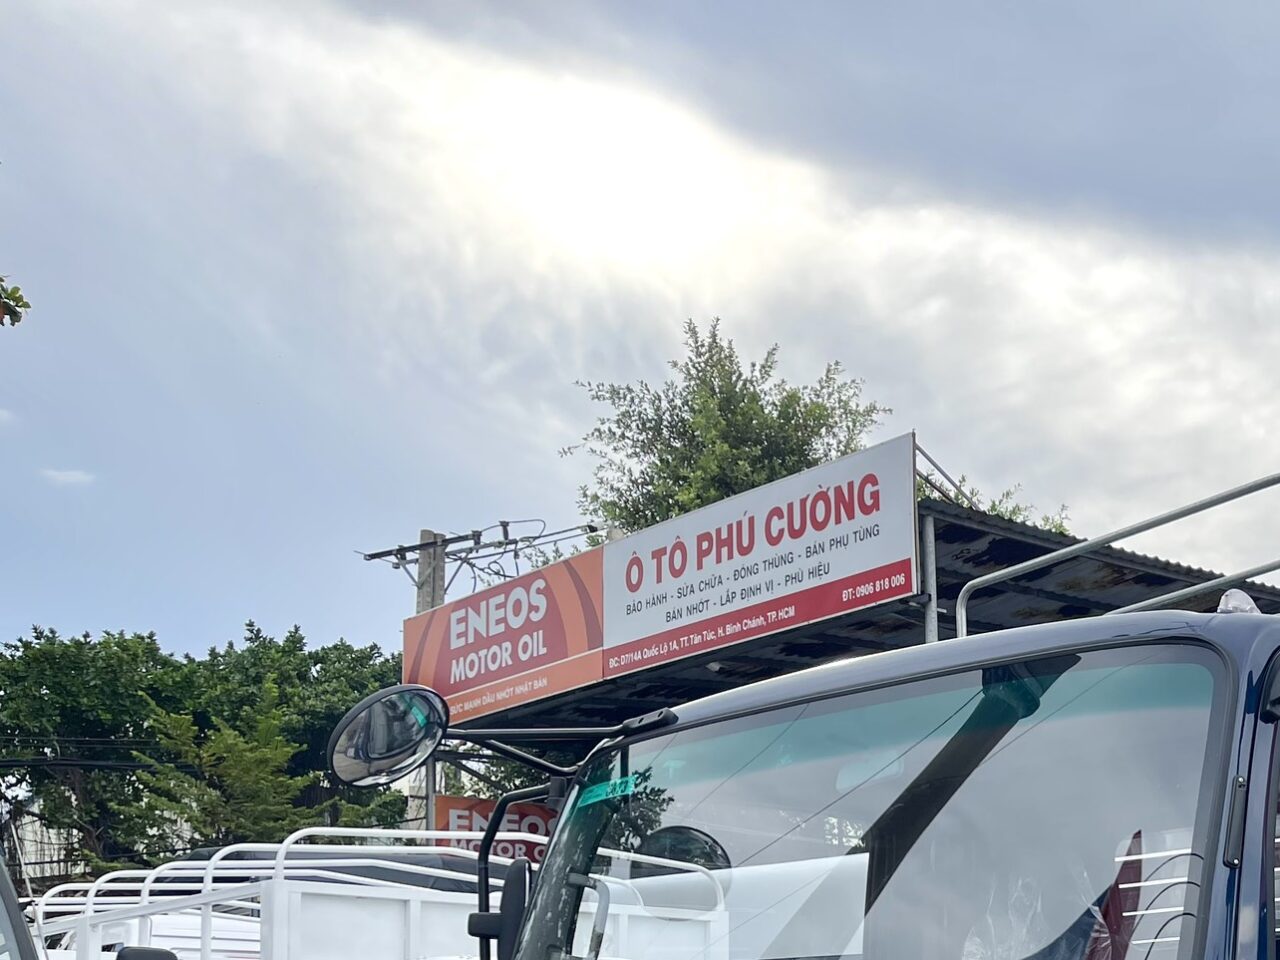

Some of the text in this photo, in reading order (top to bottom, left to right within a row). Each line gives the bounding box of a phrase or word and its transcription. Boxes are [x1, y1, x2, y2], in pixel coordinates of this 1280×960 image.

[625, 473, 880, 593] Ô TÔ PHÚ CƯỜNG
[450, 578, 547, 650] ENEOS
[855, 583, 874, 599] 0906
[875, 577, 890, 592] 818
[891, 573, 905, 589] 006
[450, 629, 547, 684] MOTOR OIL
